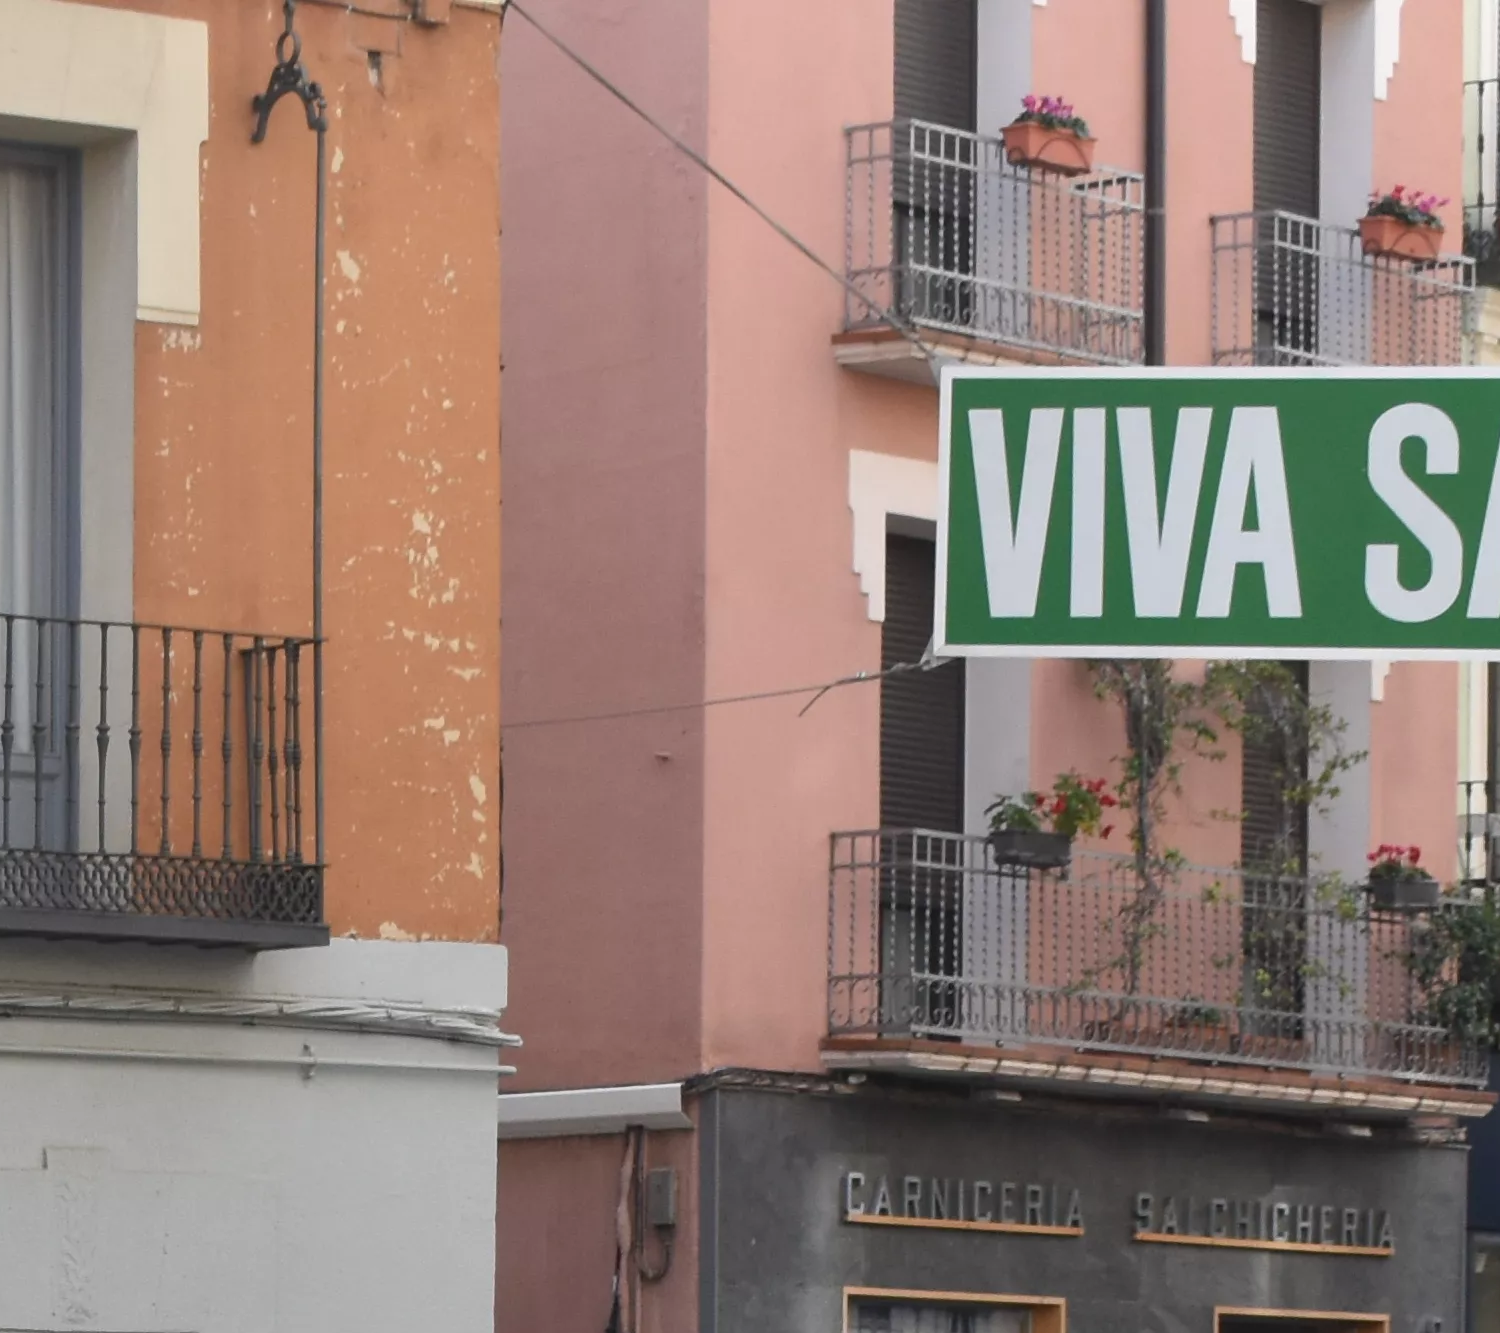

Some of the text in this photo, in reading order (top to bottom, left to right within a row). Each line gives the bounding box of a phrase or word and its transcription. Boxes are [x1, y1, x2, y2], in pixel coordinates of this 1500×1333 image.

[967, 406, 1303, 619] VIVA
[846, 1171, 1084, 1228] CARNICERIA
[1135, 1191, 1395, 1249] SALCHICHERIA
